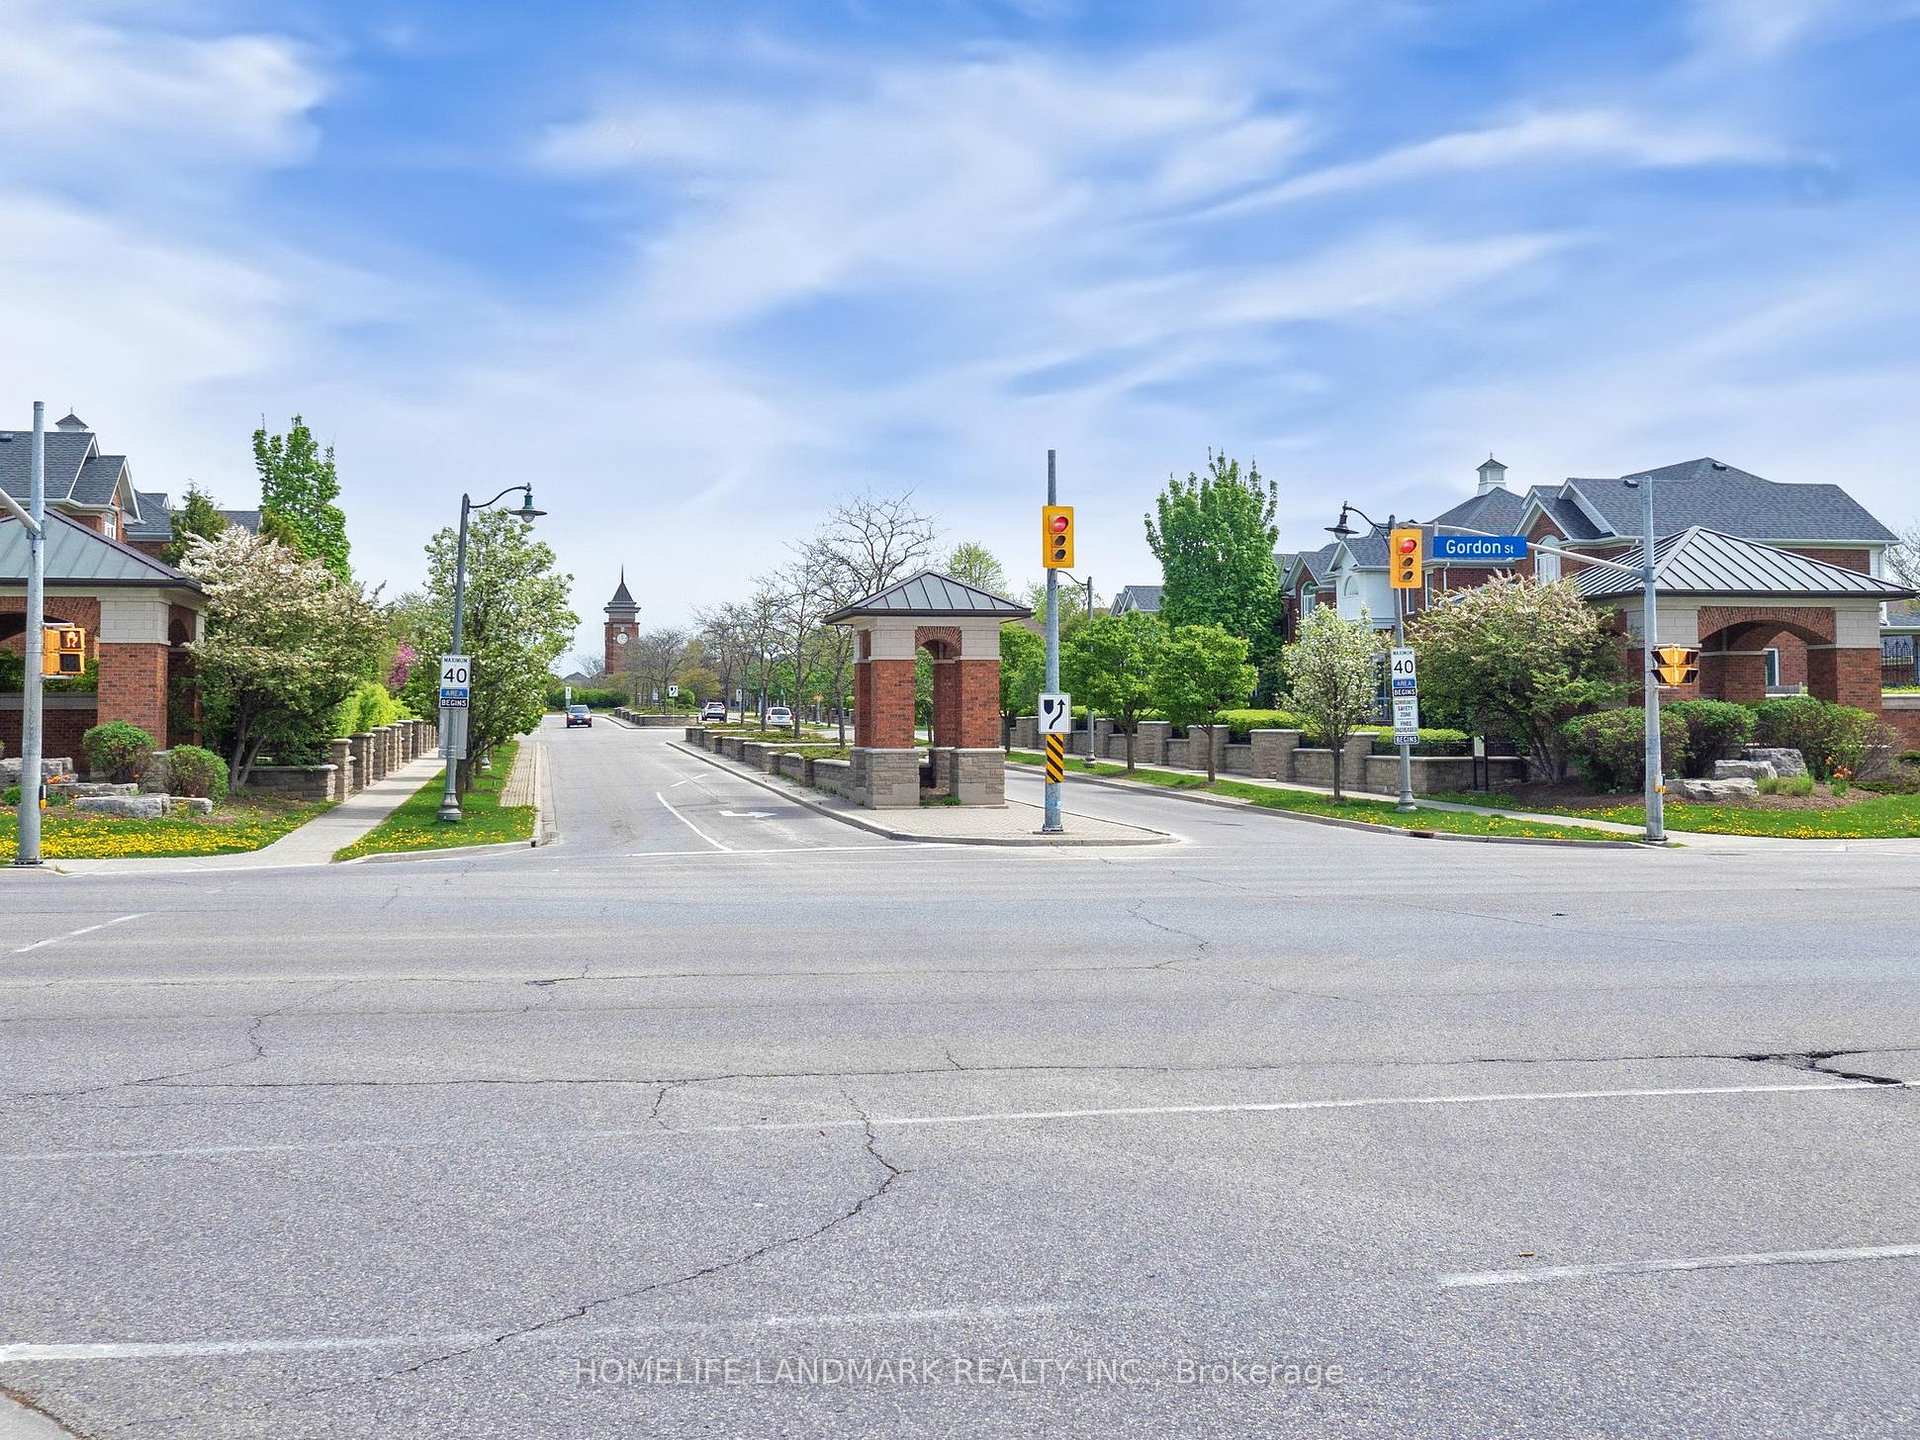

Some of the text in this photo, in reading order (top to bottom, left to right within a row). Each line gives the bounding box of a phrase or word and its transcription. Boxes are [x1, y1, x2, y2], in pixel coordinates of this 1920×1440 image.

[1446, 539, 1514, 554] Gordon St
[1393, 660, 1414, 674] 40
[443, 668, 467, 683] 40
[441, 699, 467, 707] BEGINS
